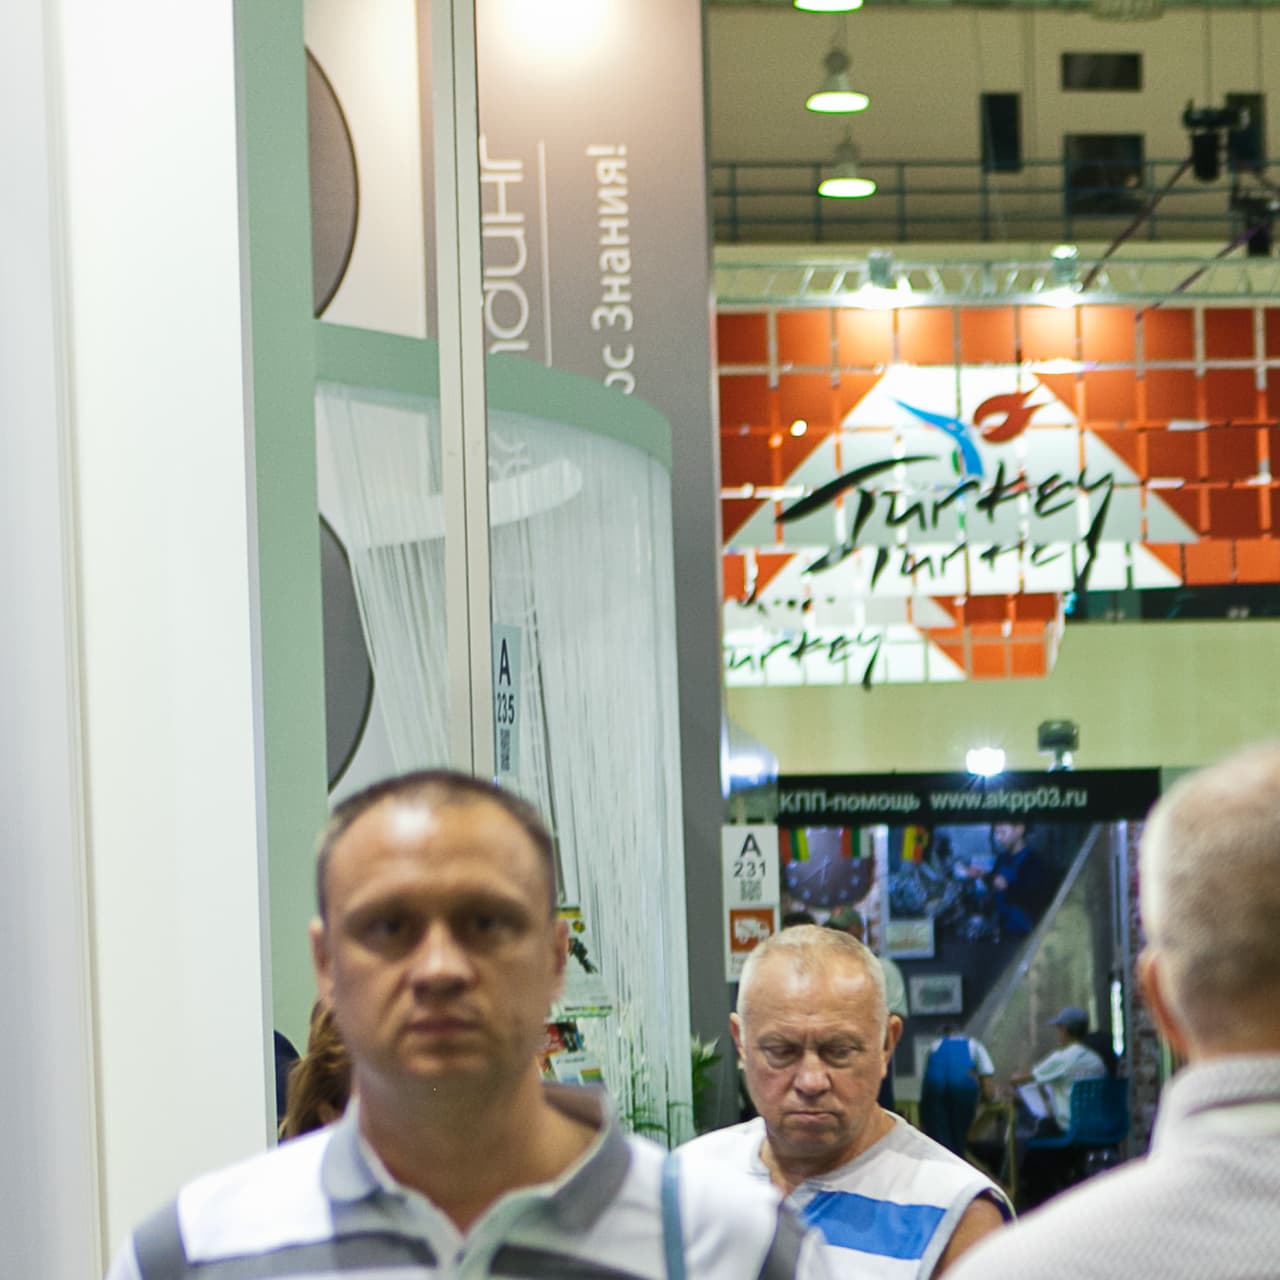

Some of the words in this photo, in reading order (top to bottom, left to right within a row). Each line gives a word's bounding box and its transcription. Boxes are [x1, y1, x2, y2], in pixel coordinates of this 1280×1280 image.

[585, 143, 633, 331] Знания!
[774, 455, 1113, 550] Turkey
[499, 638, 512, 686] A
[497, 693, 516, 725] 235
[779, 789, 920, 812] КПП-помощь
[929, 786, 1088, 813] www.akpp03.ru
[740, 832, 762, 858] A
[733, 860, 767, 878] 231
